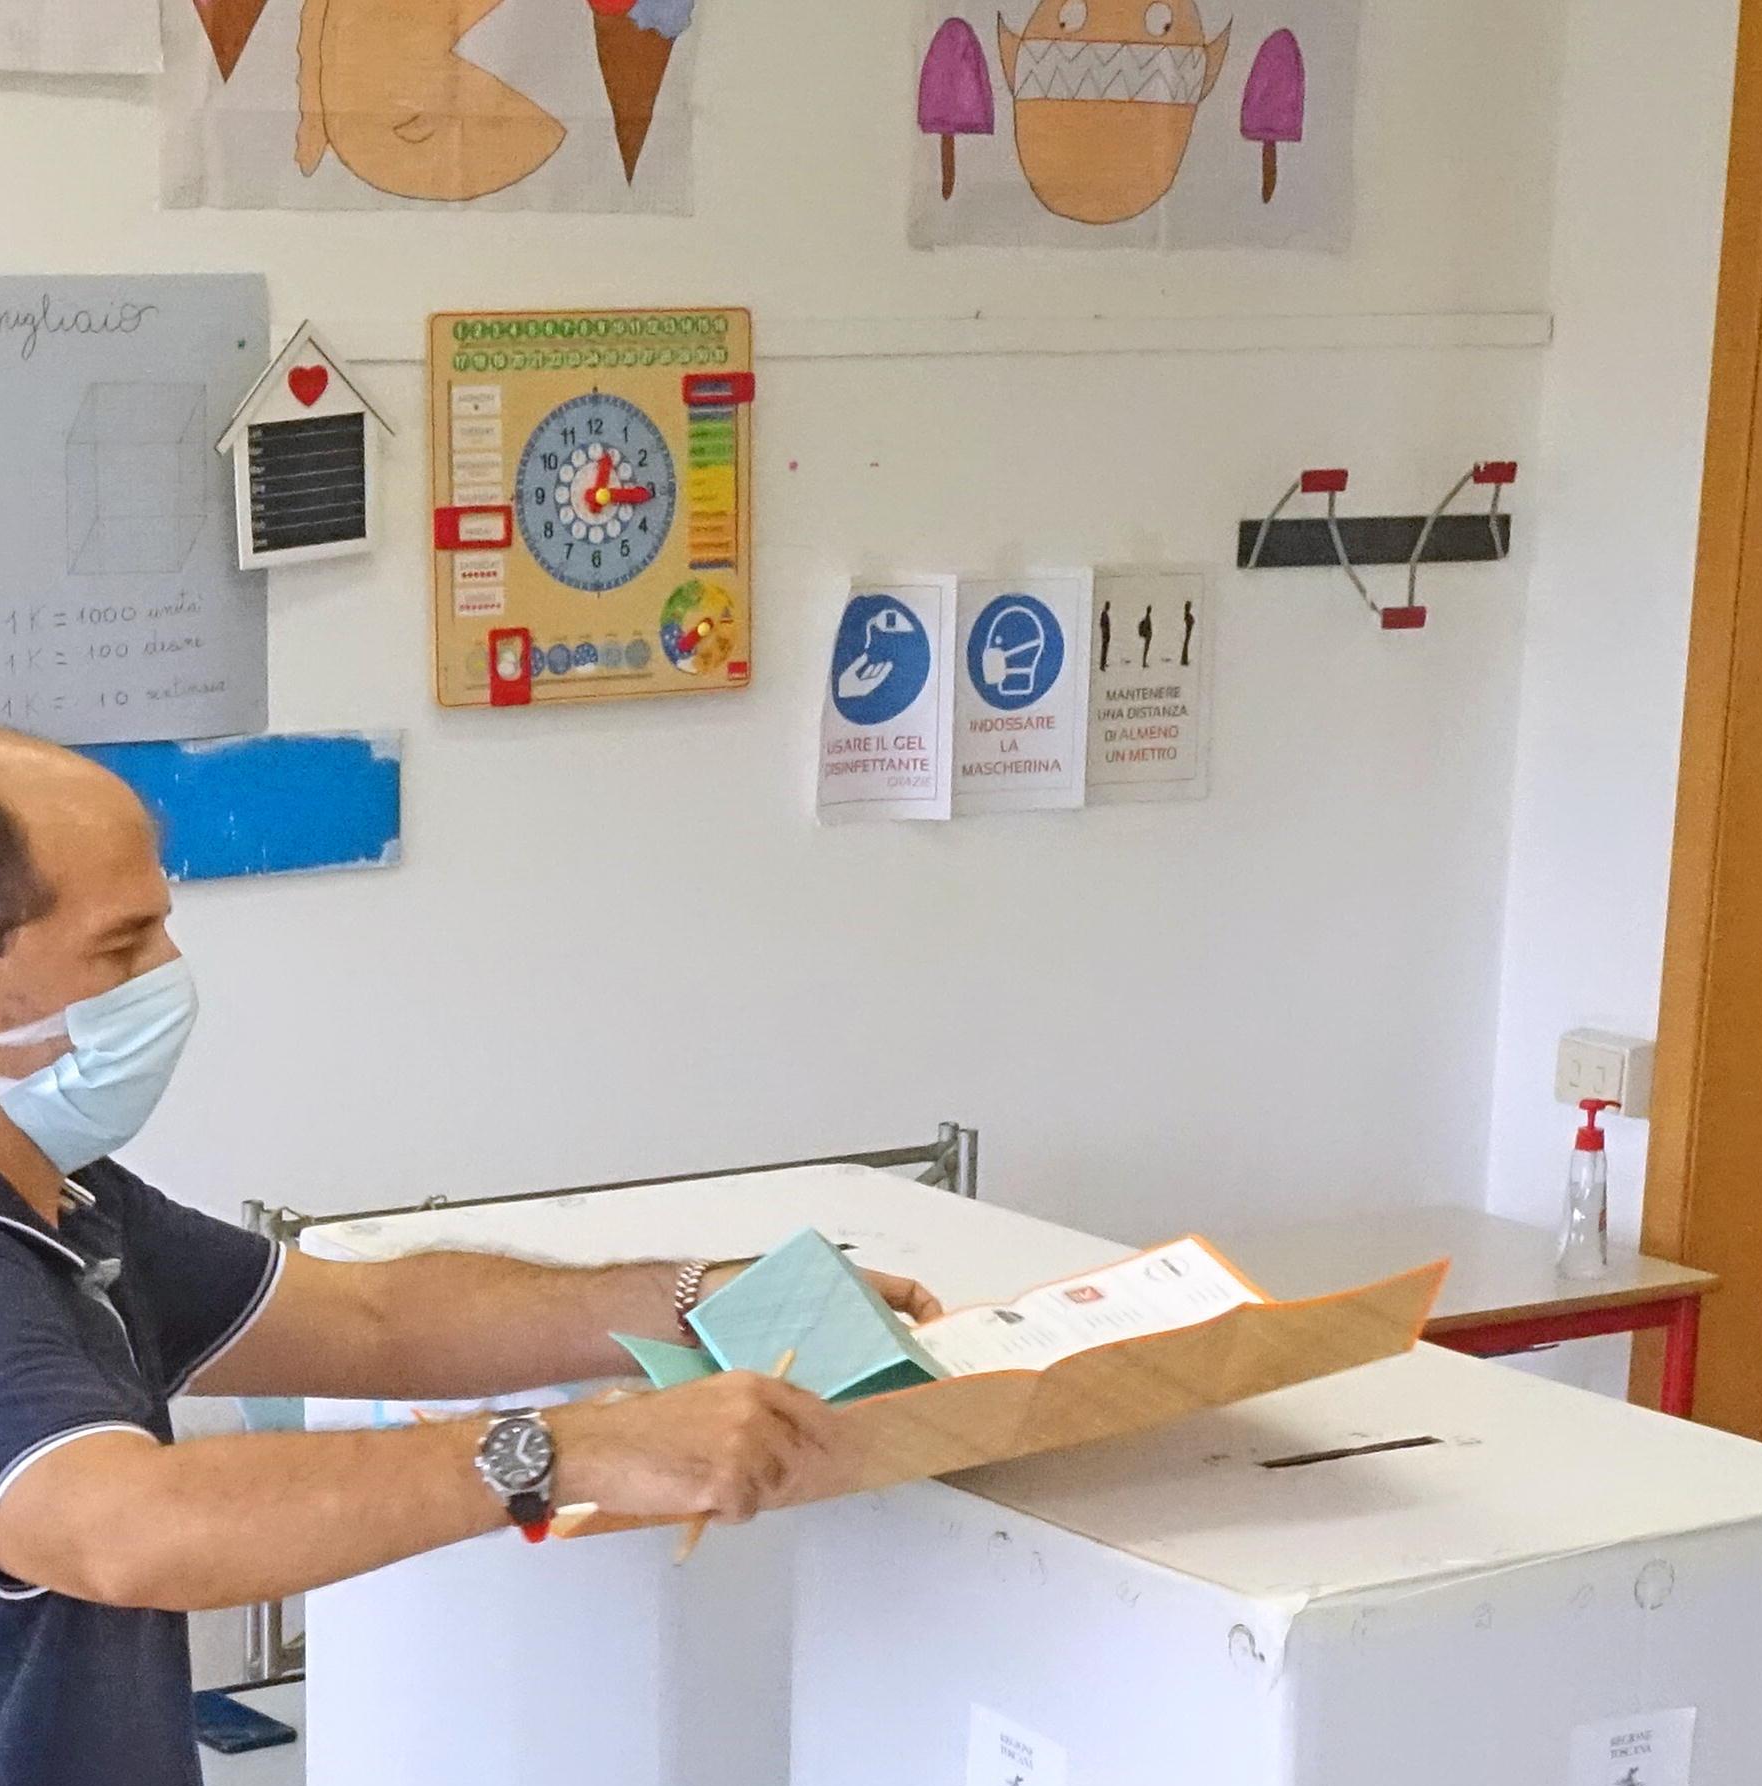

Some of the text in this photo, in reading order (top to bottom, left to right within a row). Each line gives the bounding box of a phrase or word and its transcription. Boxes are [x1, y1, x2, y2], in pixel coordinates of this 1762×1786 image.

[560, 426, 629, 445] 11 1
[587, 418, 604, 436] 12
[541, 449, 648, 470] 10 2
[535, 487, 546, 505] 9
[543, 517, 649, 539] 8 4
[565, 539, 631, 560] 7 5
[591, 550, 602, 568] 6
[76, 606, 137, 625] 1000
[89, 643, 129, 660] 100
[100, 691, 129, 708] 10
[1105, 685, 1182, 700] MANTENERE
[1096, 704, 1190, 720] UNA DISTANZA
[968, 715, 1056, 733] INDOSSARE
[1121, 725, 1180, 741] ALMENO
[826, 735, 927, 755] USARE IL GEL
[1000, 738, 1019, 753] LA
[1105, 747, 1178, 763] UN METRO
[826, 757, 931, 777] DISINFETTANTE
[961, 758, 1063, 776] MASCHERINA
